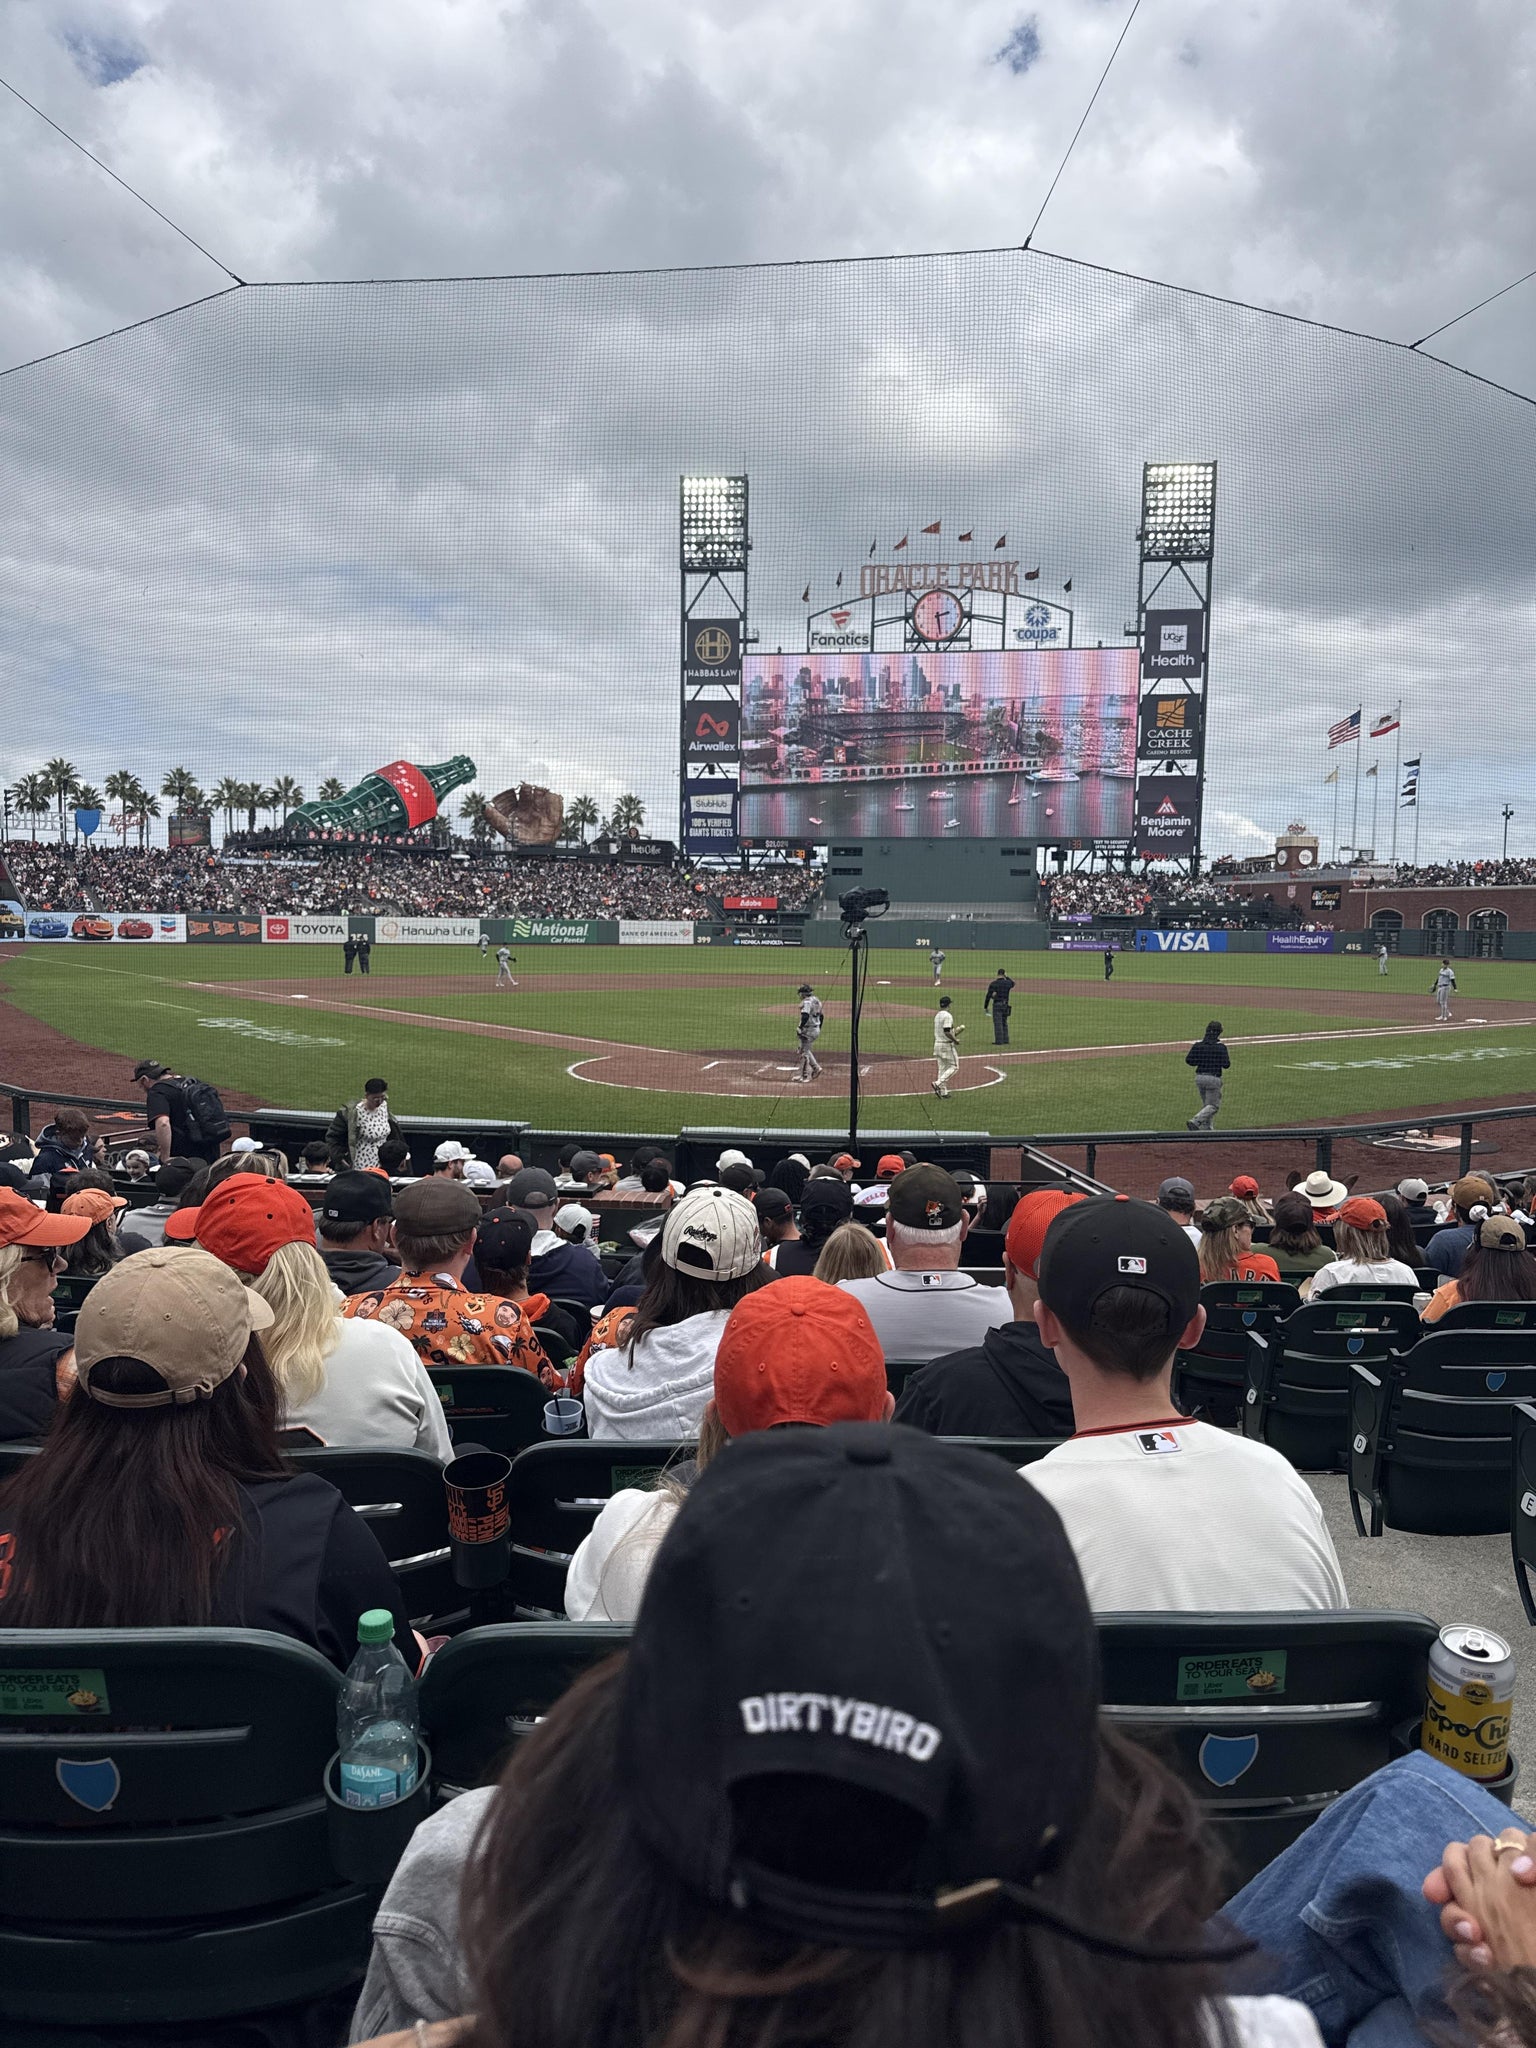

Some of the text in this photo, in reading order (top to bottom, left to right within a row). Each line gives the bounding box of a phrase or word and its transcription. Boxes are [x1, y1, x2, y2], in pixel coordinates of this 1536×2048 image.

[860, 561, 1019, 597] ORACLE PARK
[811, 632, 869, 646] Fanatics
[1017, 628, 1057, 642] coupa
[1151, 654, 1195, 667] Health
[688, 669, 738, 678] HABBAS LAW
[1147, 729, 1193, 739] CACHE
[689, 741, 735, 752] Airwallex
[1147, 738, 1191, 749] CREEK
[695, 800, 728, 808] StubHub
[707, 818, 732, 827] VERIFIED
[1141, 815, 1191, 827] Benjamin
[689, 828, 733, 838] GIANTS TICKETS
[1147, 827, 1184, 837] Moore
[739, 899, 762, 907] Adobe
[293, 924, 345, 935] TOYOTA
[401, 926, 475, 937] Hanwha Life
[531, 922, 589, 937] National
[916, 938, 930, 946] 391
[1153, 932, 1210, 951] VISA
[1272, 934, 1329, 946] HealthEquity
[1346, 943, 1362, 951] 415
[1526, 1498, 1535, 1511] E
[1185, 1656, 1263, 1672] ORDER EATS
[1185, 1666, 1262, 1679] TO YOUR SEAT
[0, 1674, 80, 1684] ORDER EATS
[1, 1684, 16, 1693] TO
[19, 1684, 50, 1693] YOUR
[740, 1692, 941, 1761] DIRTYBIRD
[1428, 1732, 1459, 1760] HARD
[351, 1765, 381, 1779] DASANI
